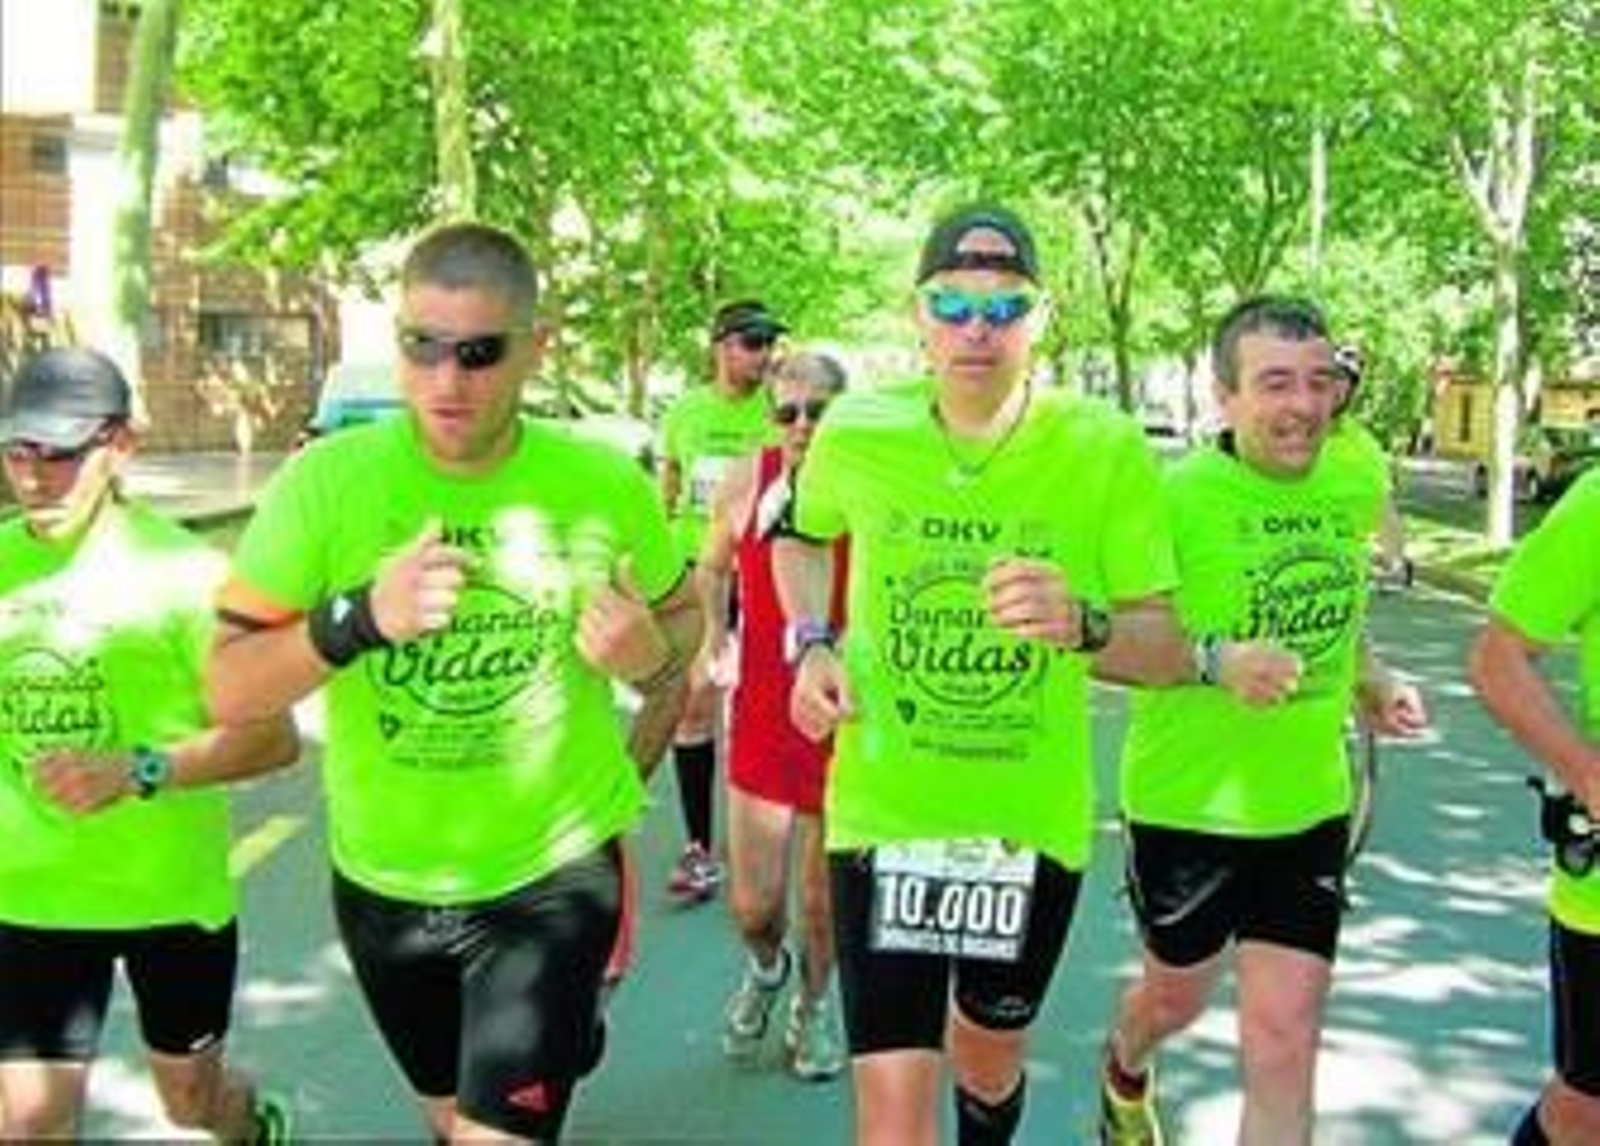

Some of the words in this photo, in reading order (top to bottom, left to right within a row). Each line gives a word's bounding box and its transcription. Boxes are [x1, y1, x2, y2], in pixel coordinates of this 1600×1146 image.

[922, 517, 1001, 543] DKV
[381, 637, 541, 687] Vidas
[888, 627, 1032, 674] Vidas
[875, 875, 1024, 937] 10.000
